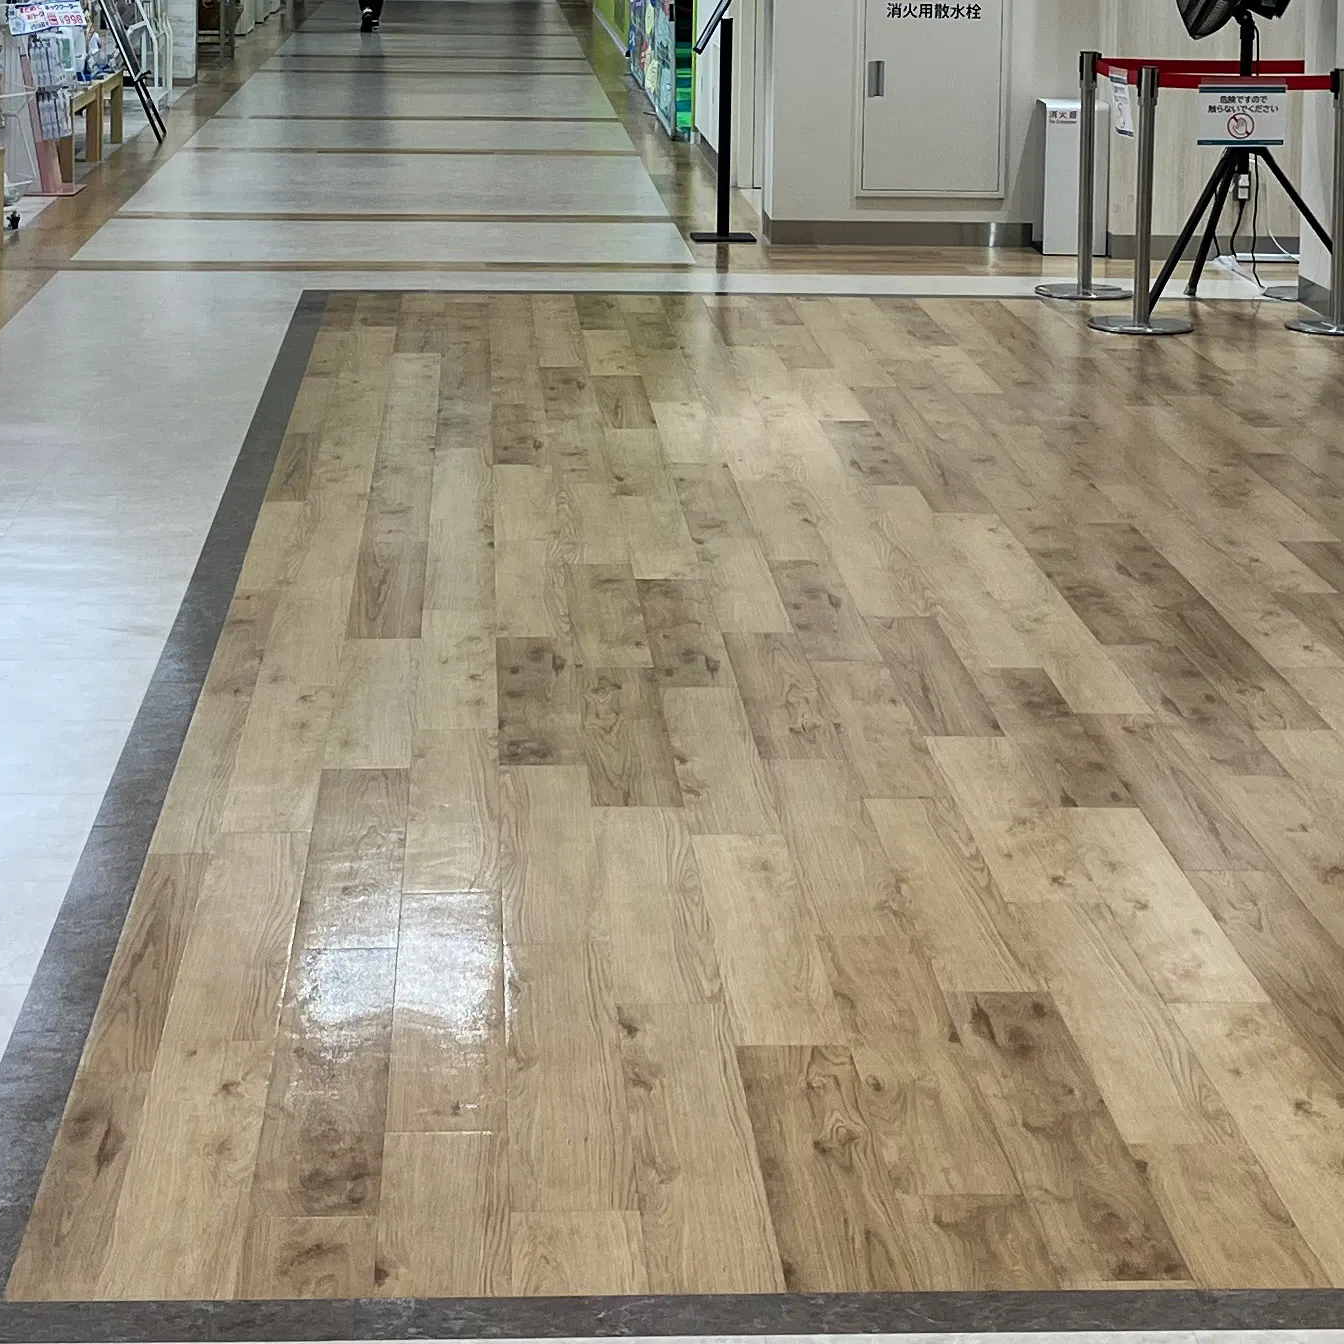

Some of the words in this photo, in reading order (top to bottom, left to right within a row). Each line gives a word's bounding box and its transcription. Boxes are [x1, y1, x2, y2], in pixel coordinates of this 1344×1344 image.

[886, 2, 982, 19] 消火用散水栓
[1219, 95, 1269, 104] 危険ですので
[1207, 104, 1280, 114] 触らないでください
